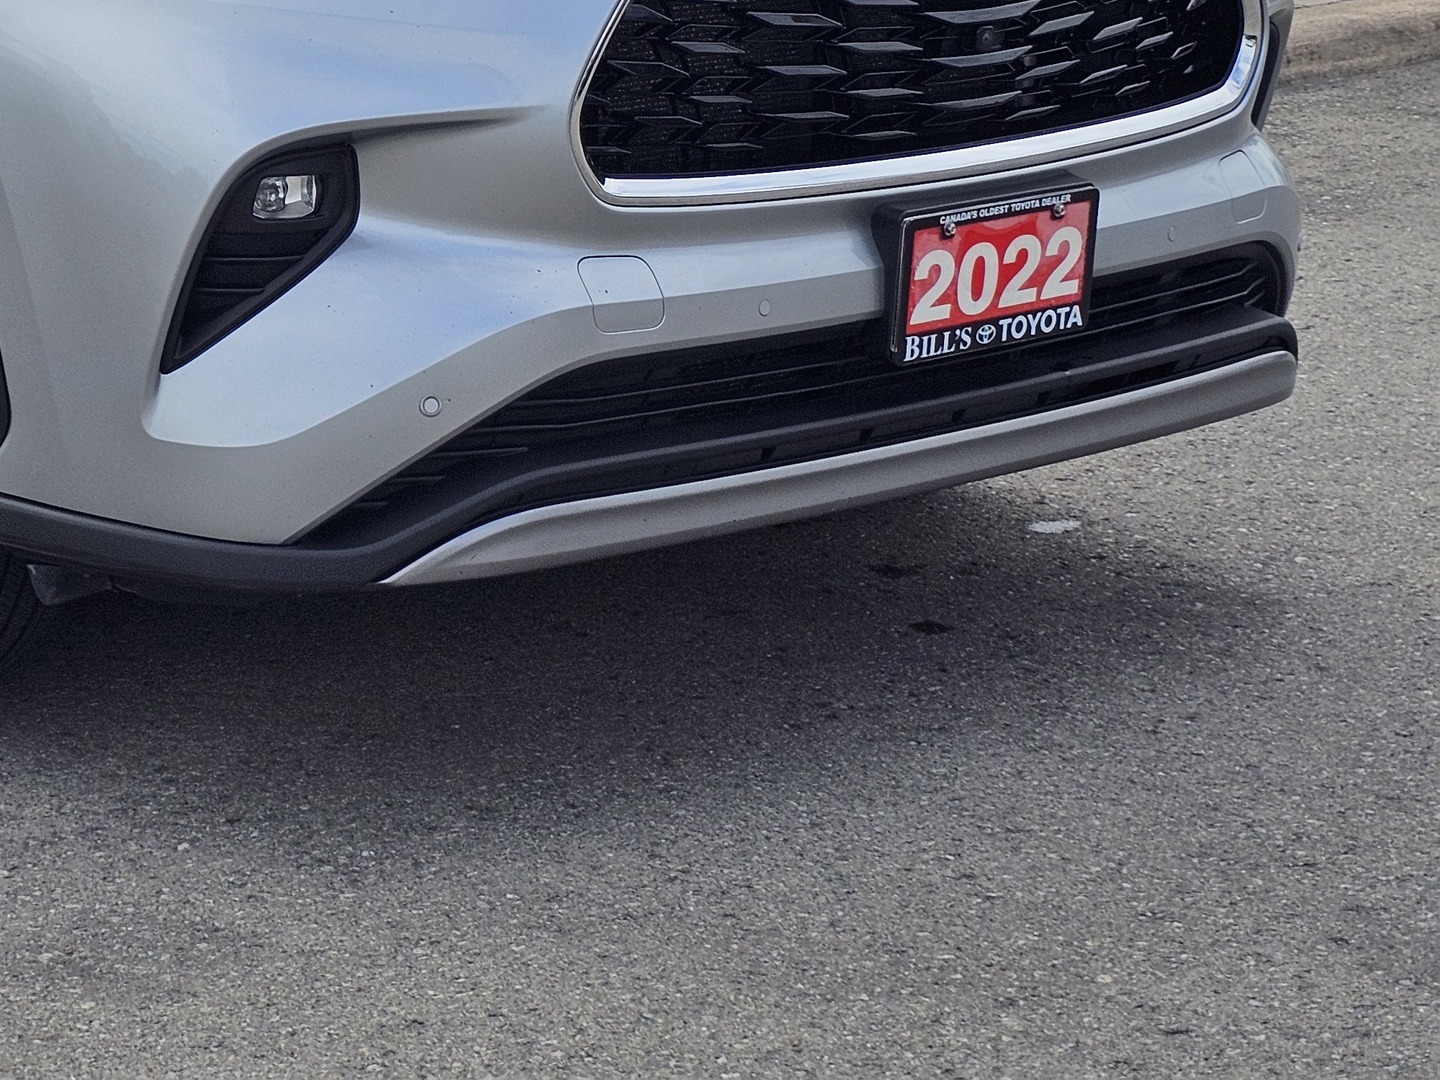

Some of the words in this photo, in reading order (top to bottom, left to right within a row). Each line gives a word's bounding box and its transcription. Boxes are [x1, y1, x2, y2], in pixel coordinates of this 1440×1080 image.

[940, 210, 978, 224] CANADA'S
[979, 206, 1009, 218] OLDEST
[1011, 200, 1040, 212] TOYOTA
[1041, 194, 1071, 206] DEALER
[910, 227, 1083, 325] 2022
[903, 327, 972, 362] BILL'S
[999, 305, 1083, 342] TOYOTA
